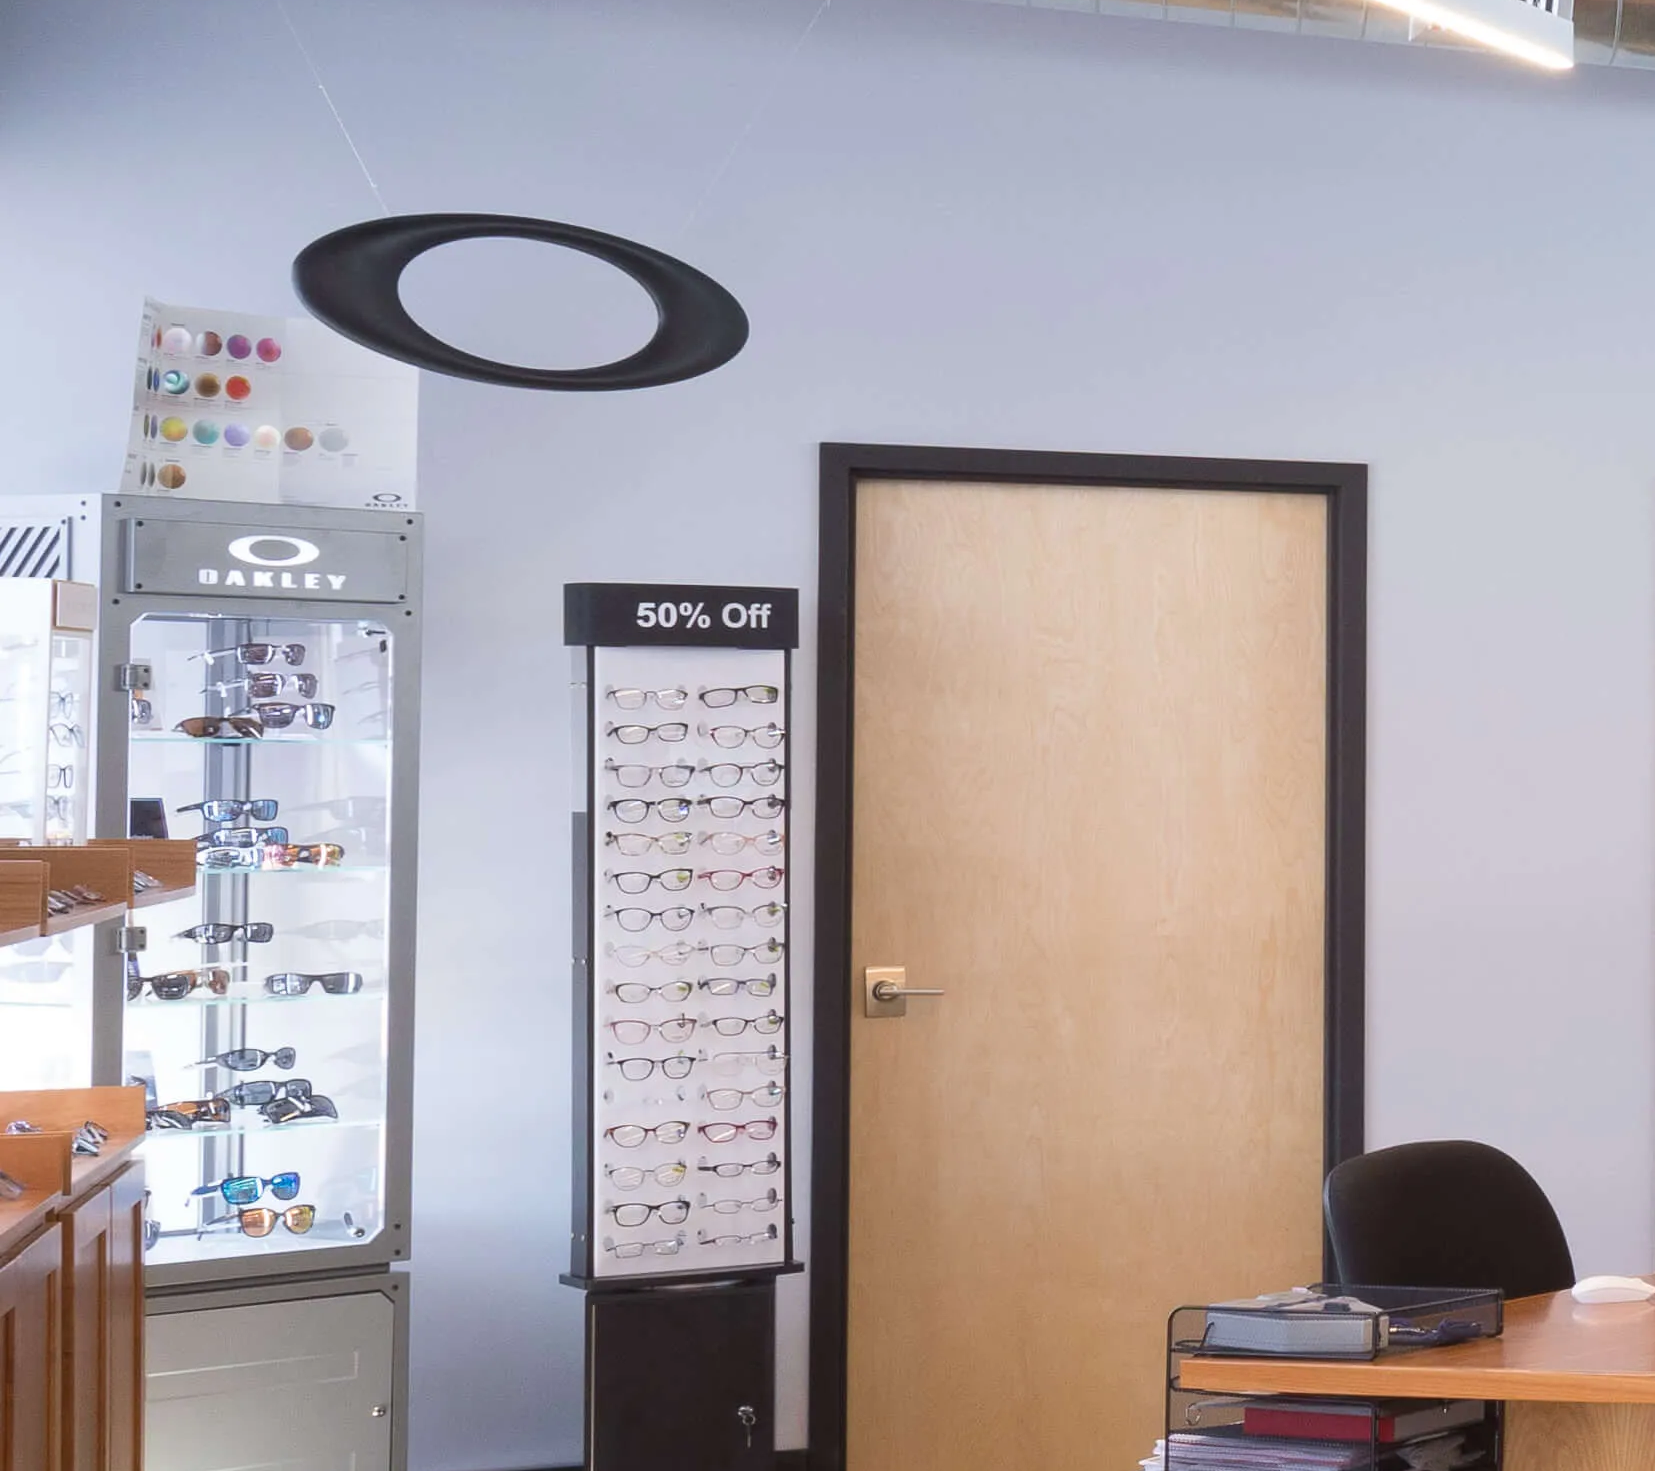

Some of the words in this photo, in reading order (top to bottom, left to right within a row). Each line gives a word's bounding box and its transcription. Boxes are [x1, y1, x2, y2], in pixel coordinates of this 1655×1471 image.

[198, 568, 347, 591] OAKLEY
[636, 602, 712, 629] 50%
[721, 602, 773, 629] Off
